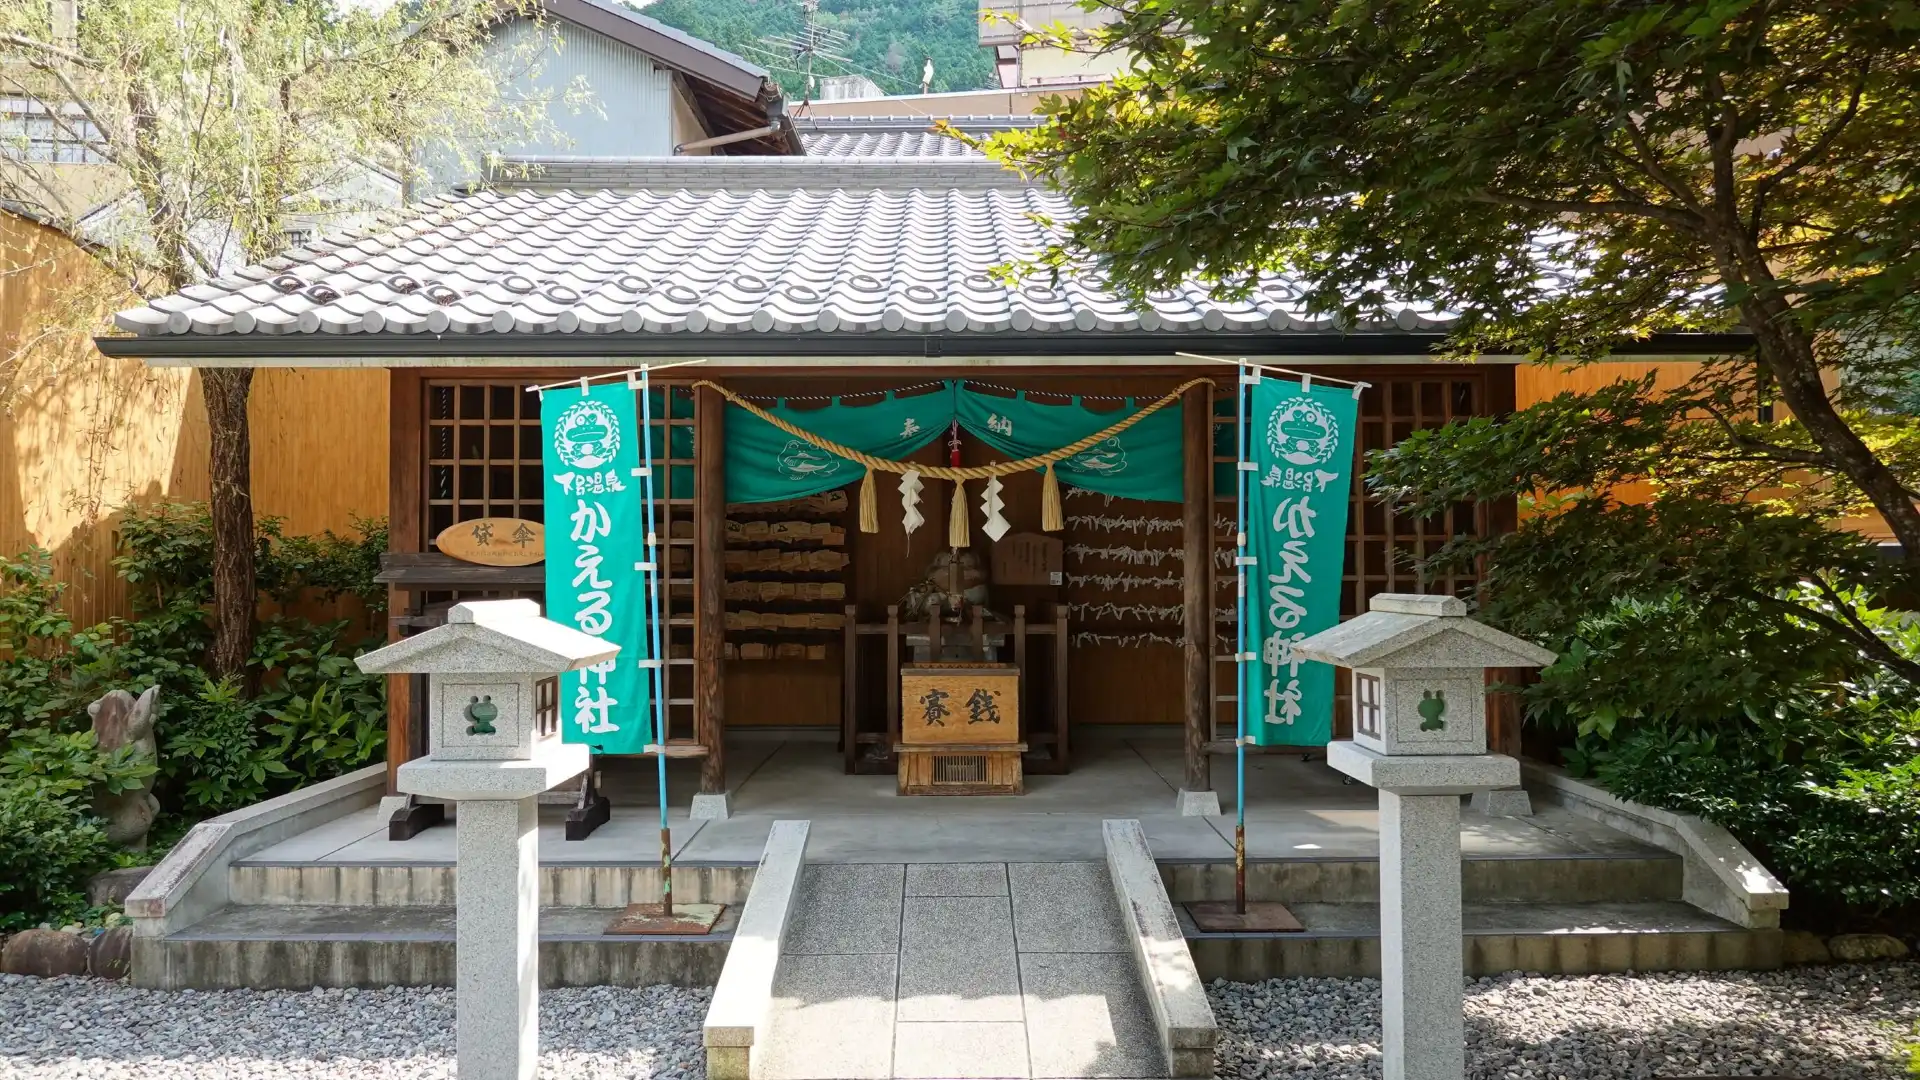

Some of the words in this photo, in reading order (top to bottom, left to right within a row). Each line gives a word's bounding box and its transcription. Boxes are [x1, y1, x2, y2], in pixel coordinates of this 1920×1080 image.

[552, 468, 627, 496] 下呂温泉
[471, 522, 536, 549] 貸傘
[919, 688, 1002, 727] 賽銭
